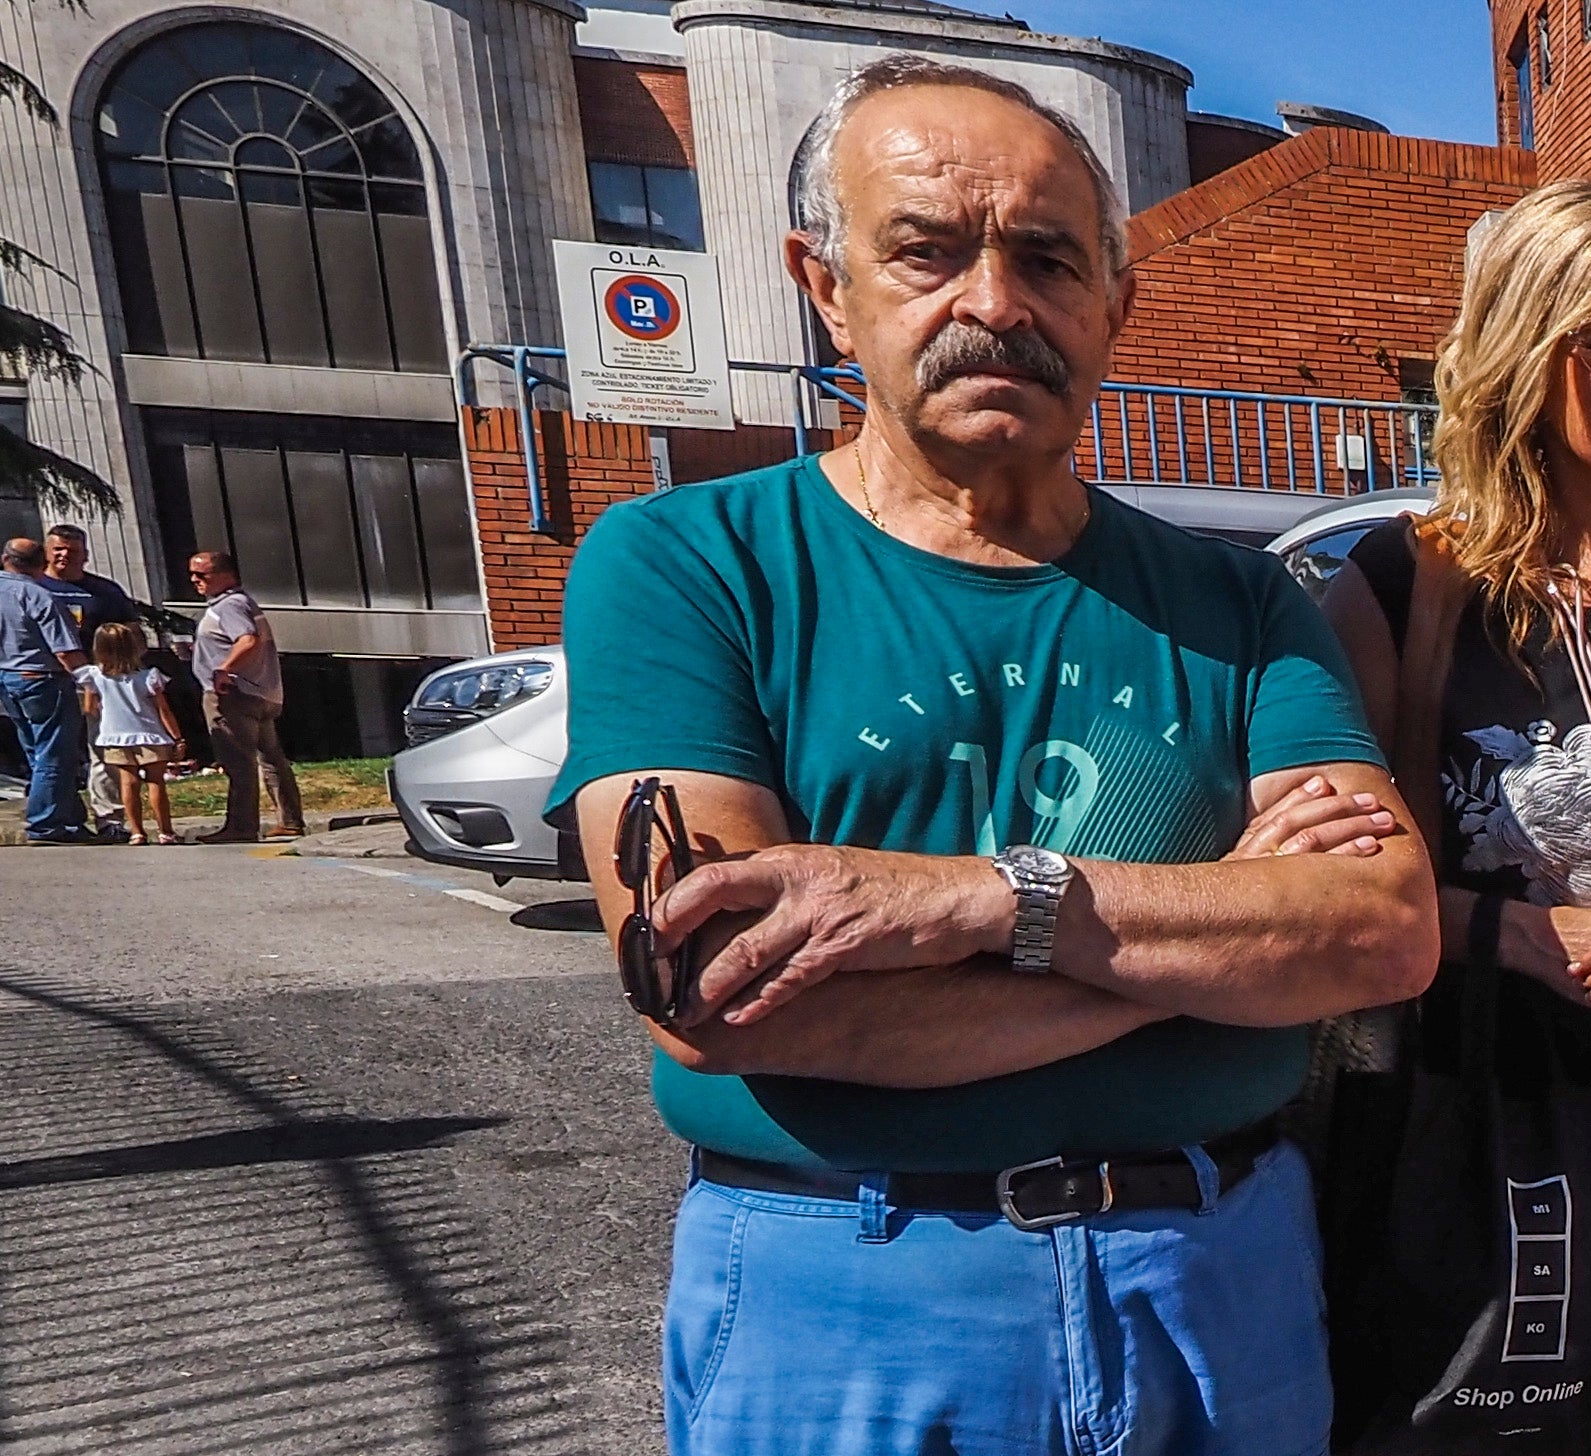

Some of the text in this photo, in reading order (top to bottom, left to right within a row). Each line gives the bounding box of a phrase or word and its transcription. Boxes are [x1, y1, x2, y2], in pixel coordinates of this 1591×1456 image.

[633, 299, 647, 314] P
[857, 662, 1181, 753] ETERNAL
[1533, 1265, 1551, 1276] SA
[1526, 1322, 1545, 1334] KO
[1453, 1380, 1584, 1410] Shop Online
